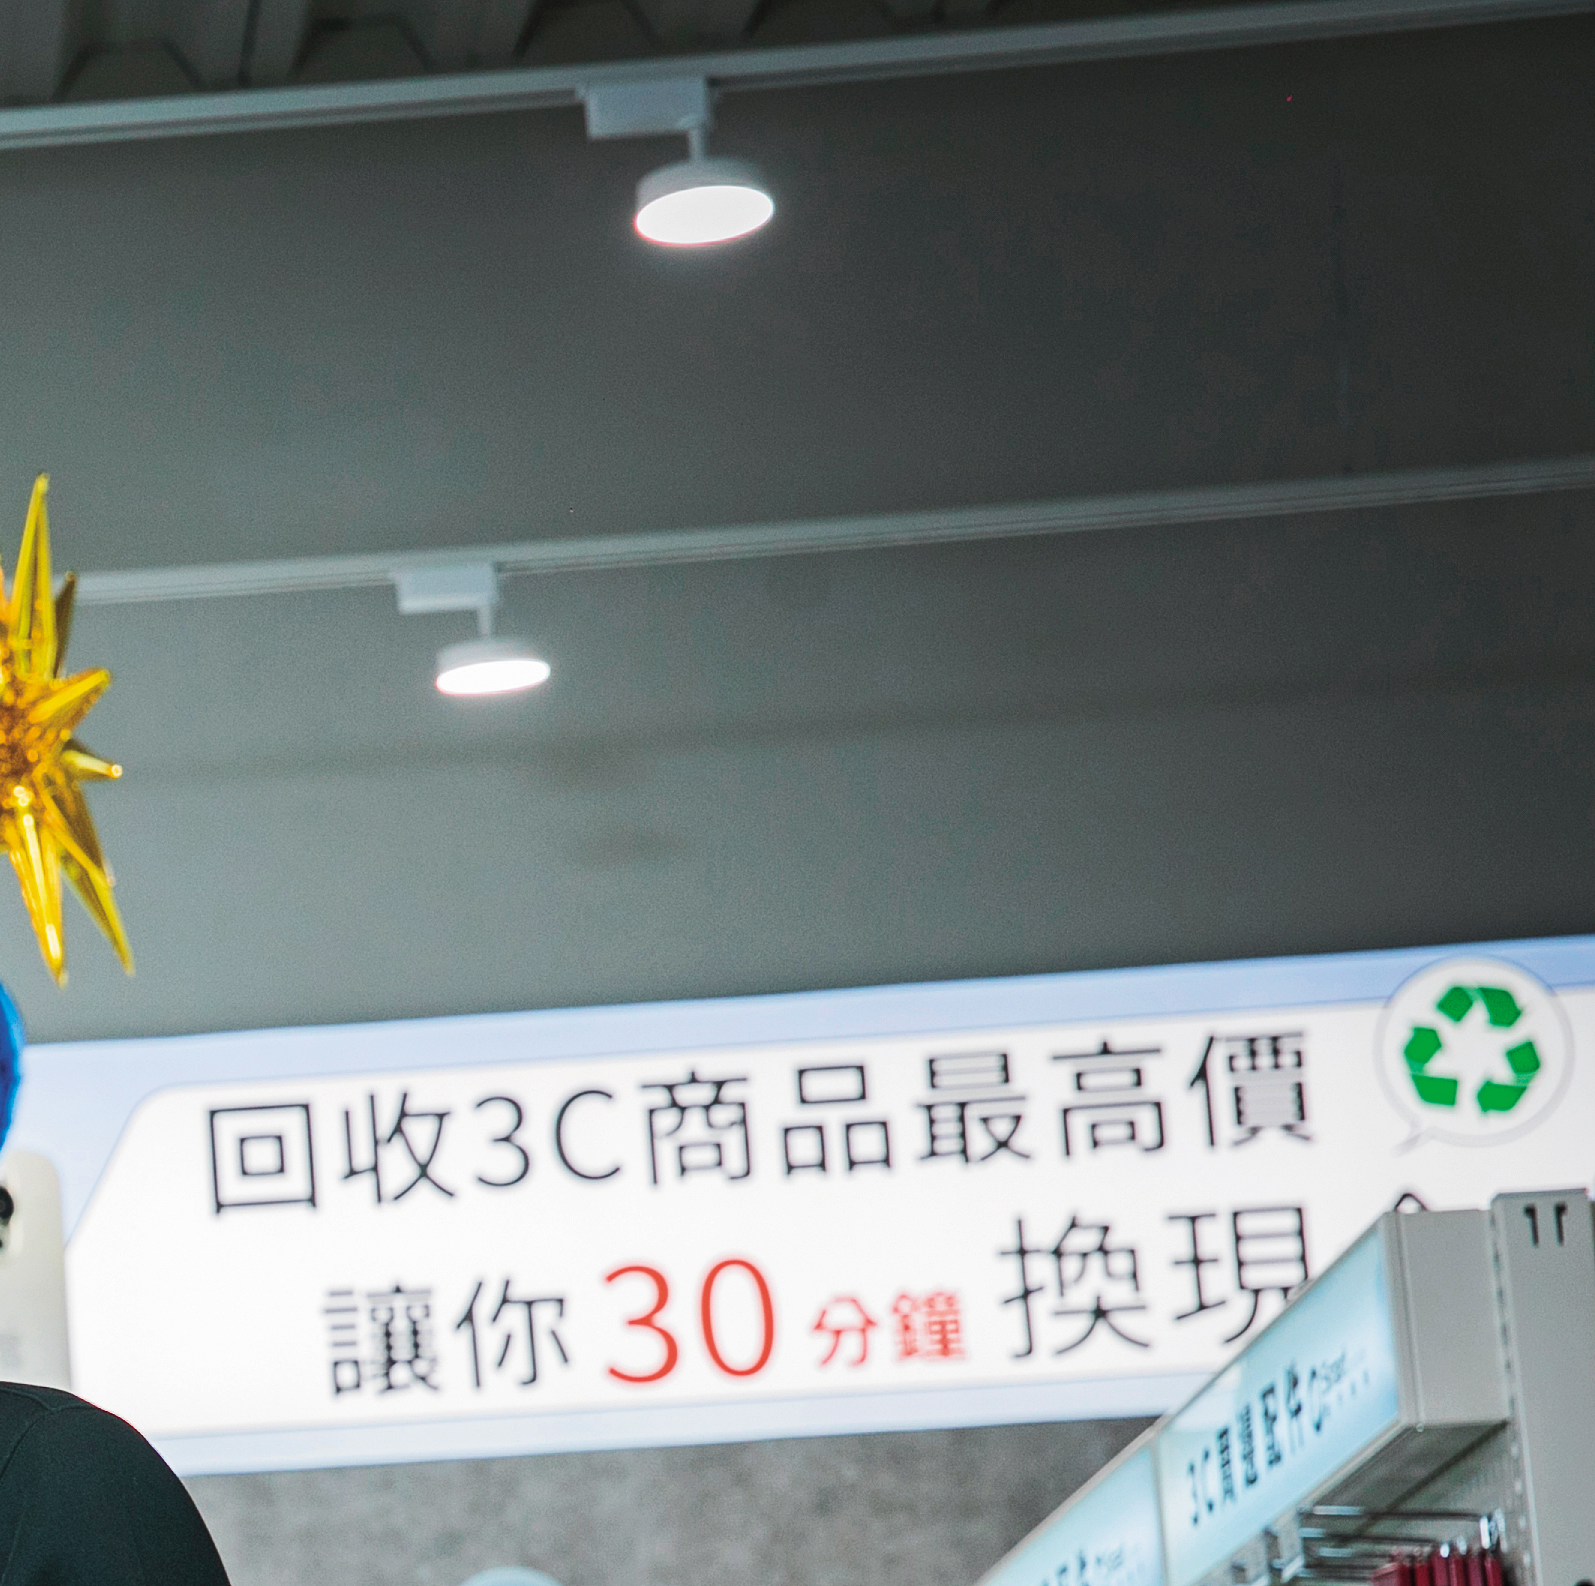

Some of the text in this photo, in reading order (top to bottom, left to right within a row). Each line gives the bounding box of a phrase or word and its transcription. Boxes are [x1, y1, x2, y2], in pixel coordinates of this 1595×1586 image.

[207, 1029, 1313, 1216] 回收3C商品最高價
[322, 1193, 1428, 1398] 讓你 30 分鐘 換現
